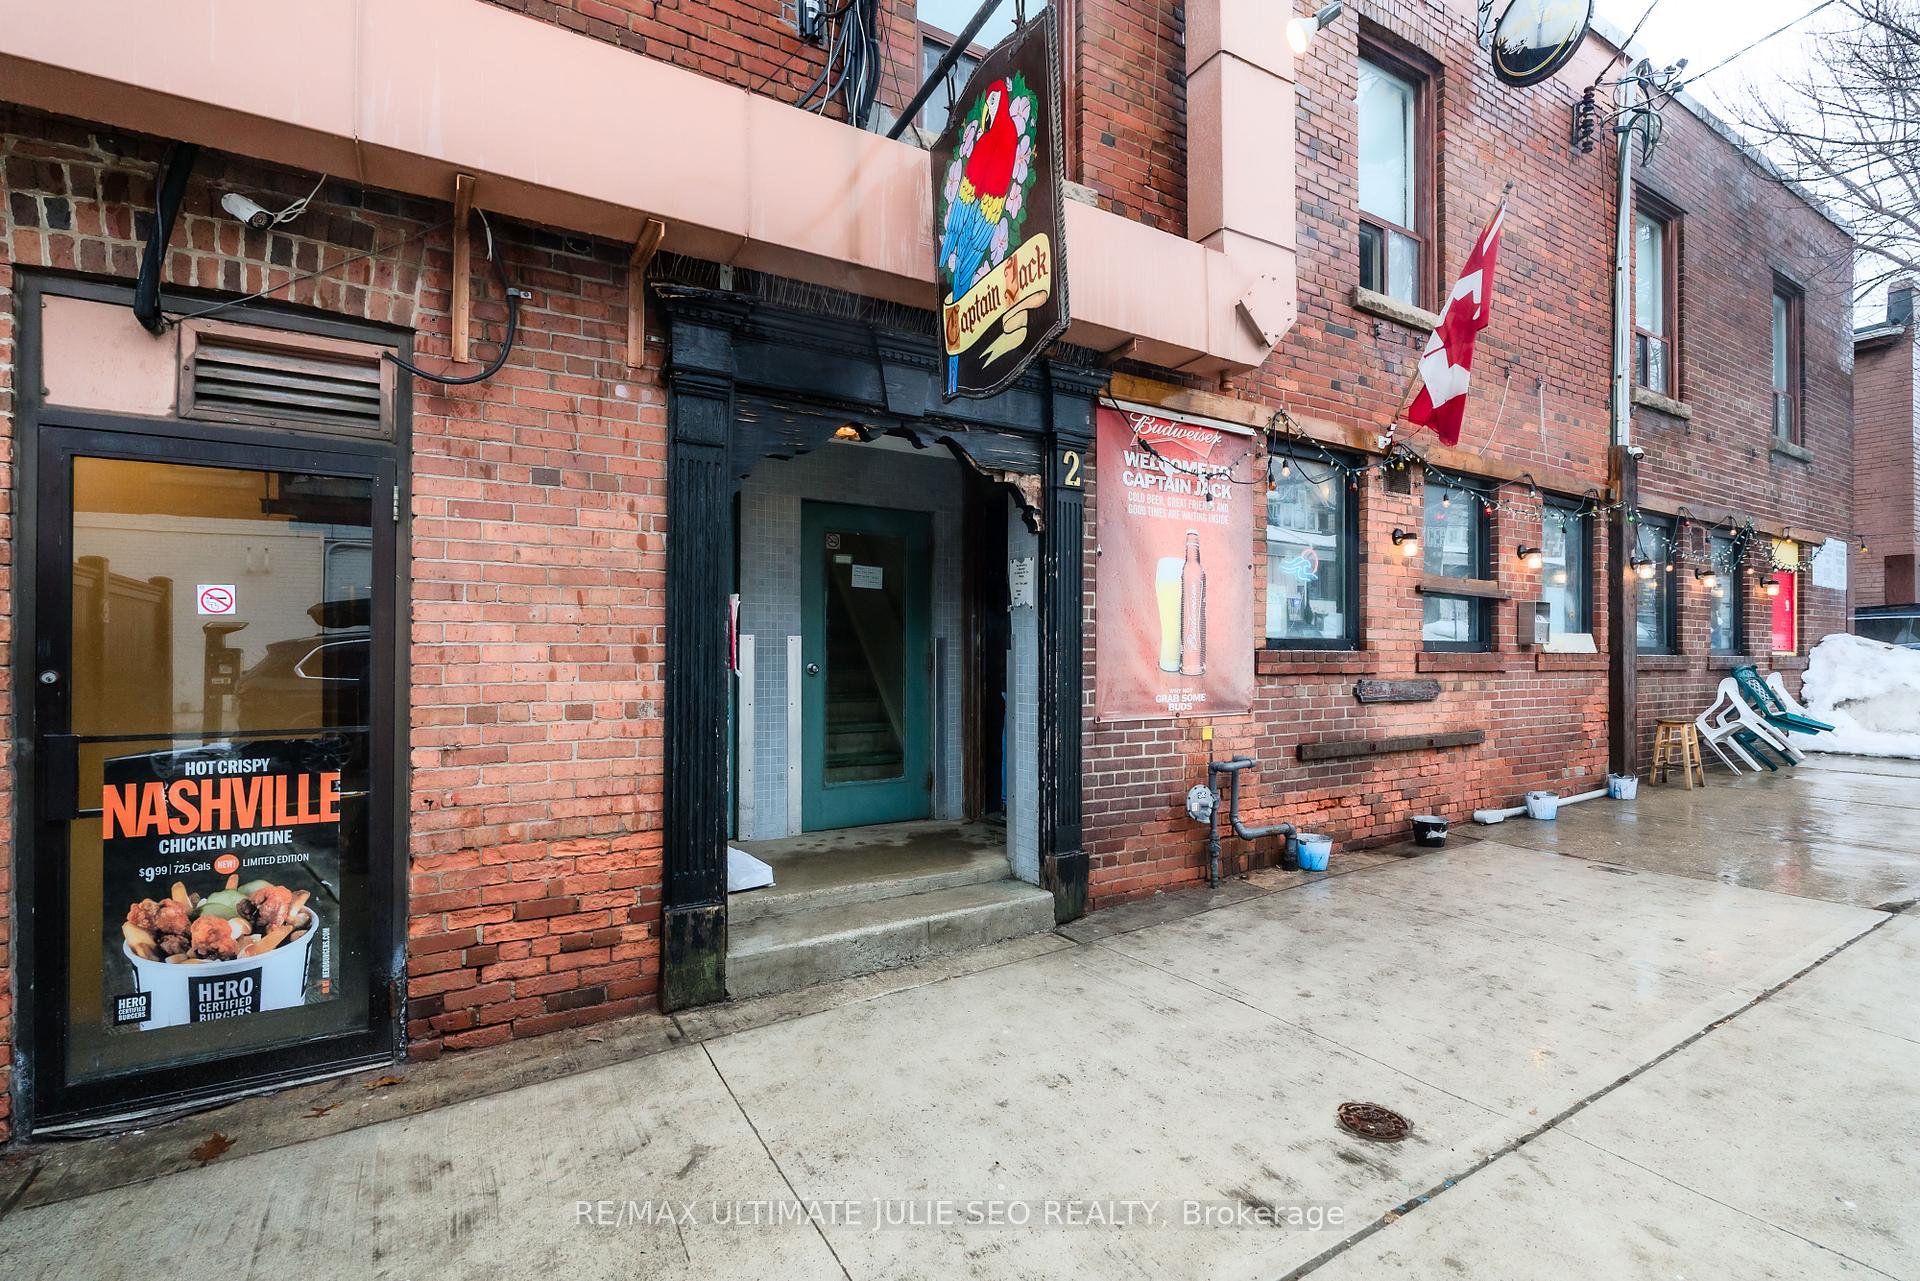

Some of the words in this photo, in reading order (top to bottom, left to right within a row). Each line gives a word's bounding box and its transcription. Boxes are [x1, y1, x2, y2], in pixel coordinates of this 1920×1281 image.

[946, 284, 1001, 347] Captain
[1003, 245, 1048, 304] Jack
[1130, 413, 1222, 445] Budweiser
[1063, 451, 1080, 486] 2
[1122, 470, 1192, 494] CAPTAIN
[1194, 477, 1232, 500] JACK
[1128, 491, 1144, 503] COLD
[1168, 497, 1187, 508] GREAT
[1217, 502, 1229, 512] AND
[1156, 694, 1179, 703] GRAB
[1181, 693, 1206, 702] SOME
[1168, 702, 1193, 711] BUDS
[185, 760, 216, 776] HOT
[217, 758, 270, 773] CRISPY
[103, 772, 341, 840] NASHVILLE
[159, 835, 226, 854] CHICKEN
[231, 829, 293, 849] POUTINE
[173, 864, 191, 874] 725
[192, 863, 211, 872] Cals
[242, 856, 275, 867] LIMITED
[276, 853, 310, 864] EDITION
[199, 977, 254, 1003] HERO
[118, 996, 146, 1009] HERO
[118, 1006, 146, 1015] CERTIFIED
[199, 996, 252, 1013] CERTIFIED
[118, 1012, 146, 1021] BURGERS
